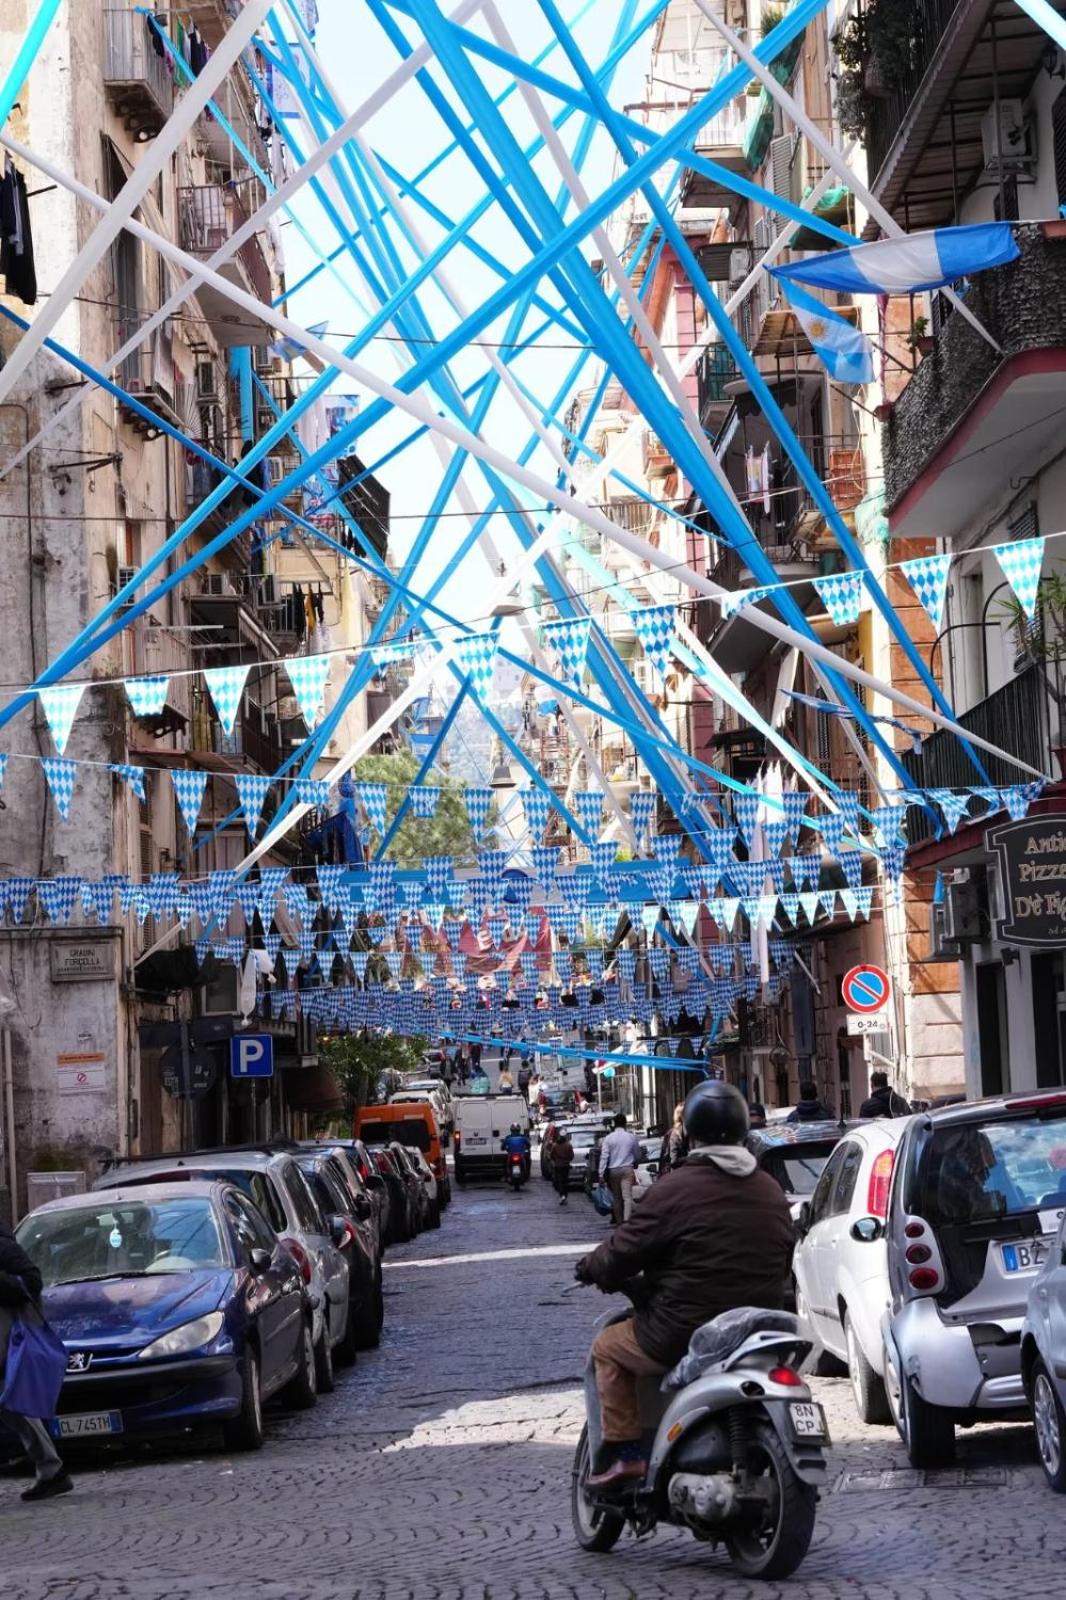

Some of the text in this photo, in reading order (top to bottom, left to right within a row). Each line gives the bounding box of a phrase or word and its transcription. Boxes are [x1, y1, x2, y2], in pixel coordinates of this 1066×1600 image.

[857, 1020, 878, 1028] 0-24
[240, 1039, 264, 1073] P
[61, 1420, 74, 1434] CL
